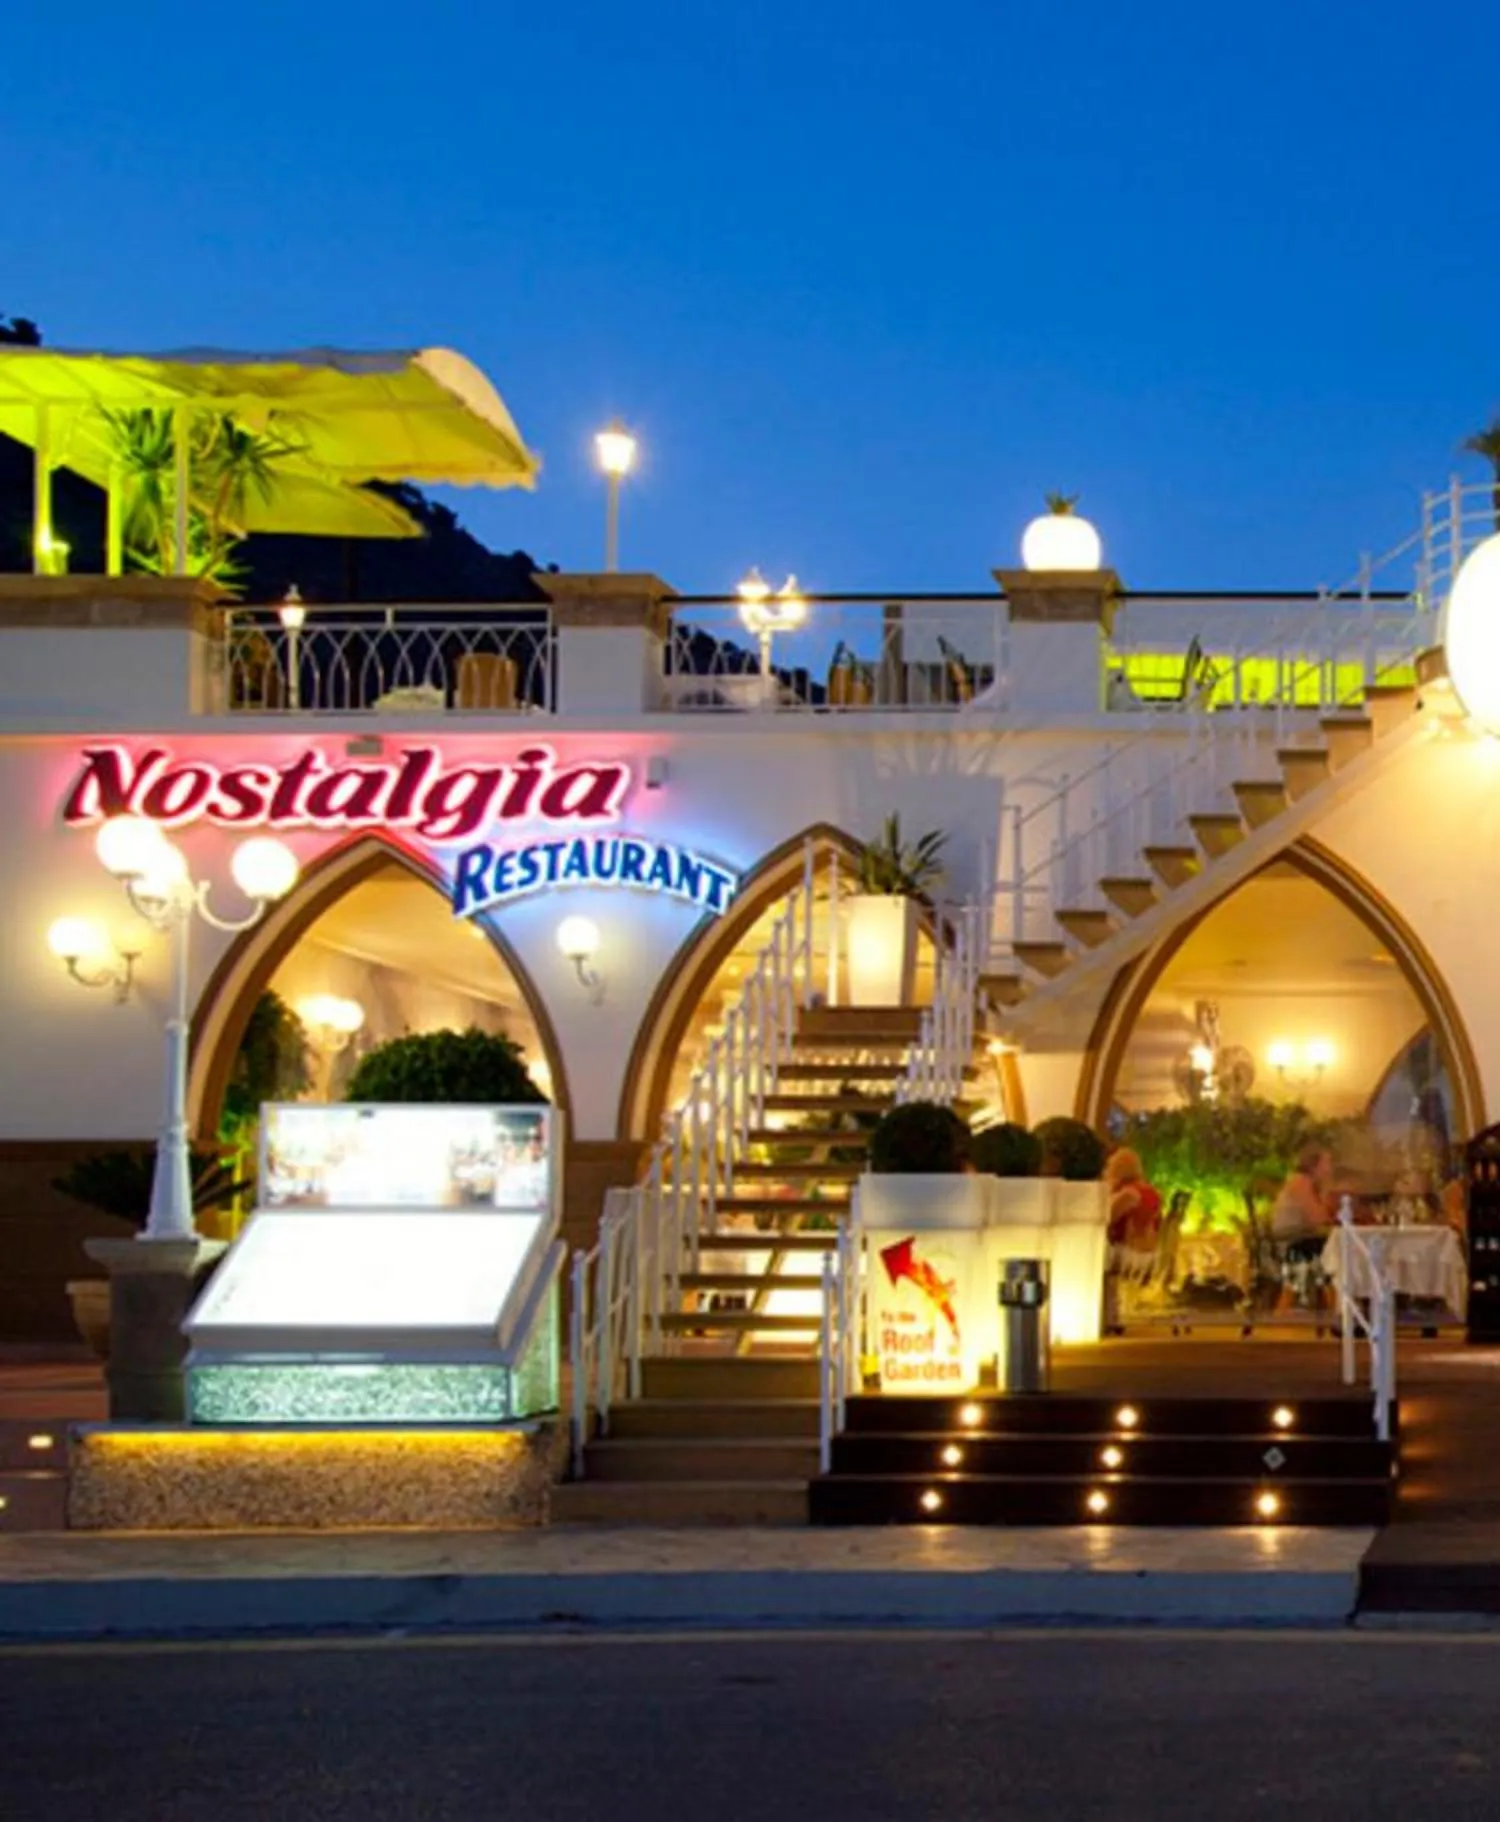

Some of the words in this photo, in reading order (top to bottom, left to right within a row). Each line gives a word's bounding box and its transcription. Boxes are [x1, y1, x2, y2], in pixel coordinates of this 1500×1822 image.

[63, 746, 626, 839] Nostalgia
[452, 840, 735, 916] RESTAURANT
[882, 1328, 935, 1353] Roof
[884, 1358, 962, 1381] Garden
